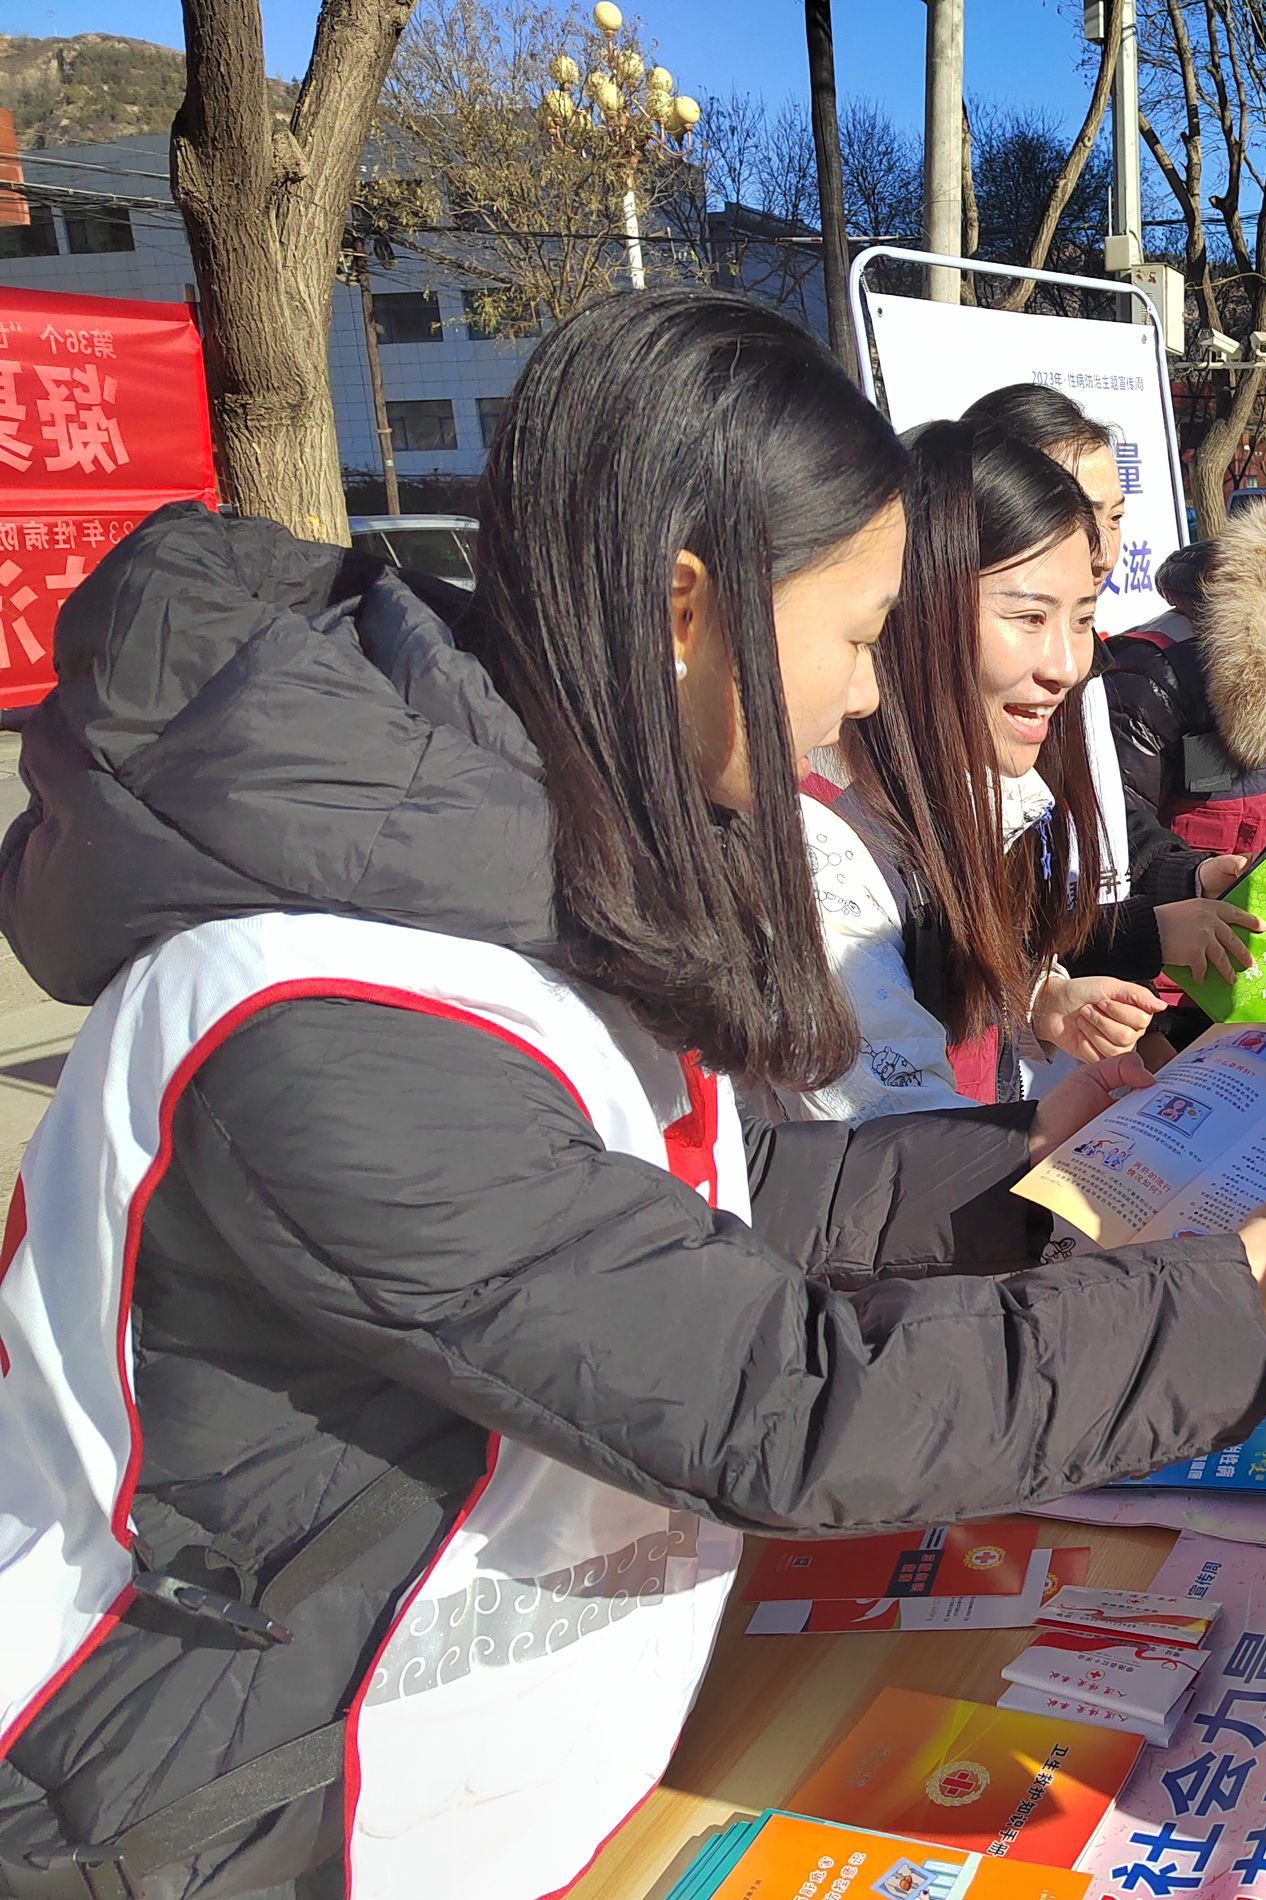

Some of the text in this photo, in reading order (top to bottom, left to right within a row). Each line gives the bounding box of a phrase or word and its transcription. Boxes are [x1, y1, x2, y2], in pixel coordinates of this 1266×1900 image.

[1116, 443, 1144, 494] 量
[986, 1742, 1070, 1858] 卫生救护知识手册
